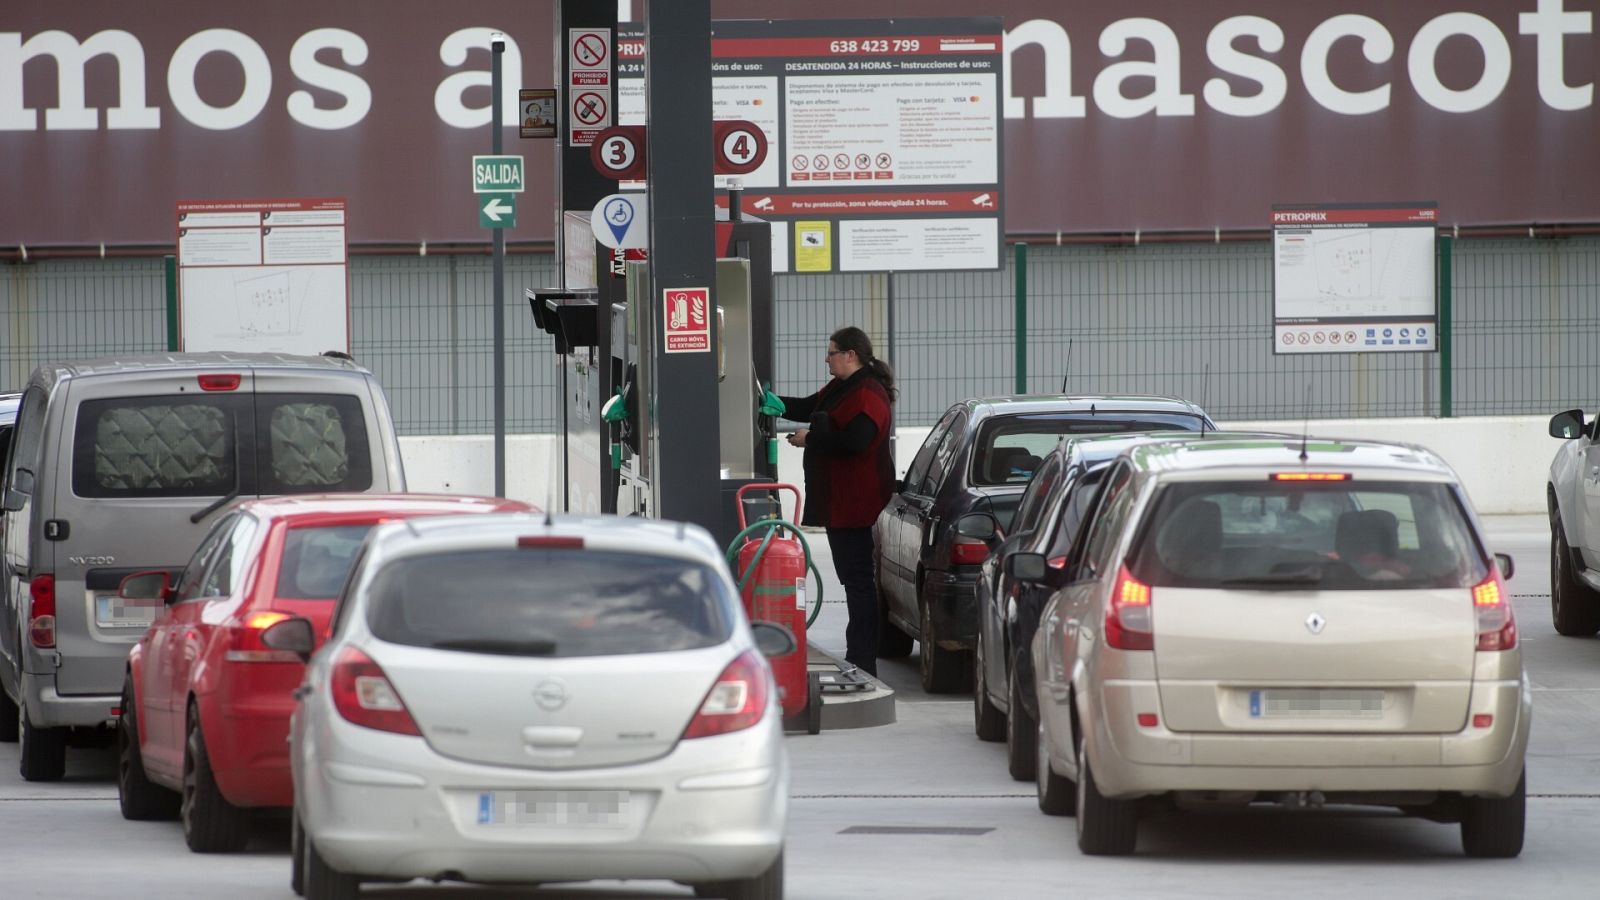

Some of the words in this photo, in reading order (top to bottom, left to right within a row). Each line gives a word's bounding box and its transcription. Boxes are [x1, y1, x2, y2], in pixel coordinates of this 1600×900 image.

[830, 41, 857, 53] 638
[861, 40, 889, 52] 423
[892, 39, 920, 52] 799
[628, 64, 639, 72] 24
[731, 62, 742, 71] de
[744, 63, 763, 71] uso:
[785, 62, 846, 71] DESATENDIDA
[848, 62, 859, 70] 24
[861, 61, 892, 70] HORAS
[901, 60, 957, 69] Instrucciones
[959, 60, 970, 68] de
[609, 140, 627, 165] 3
[731, 135, 750, 160] 4
[476, 163, 521, 185] SALIDA
[813, 200, 848, 209] protección,
[849, 200, 866, 208] zona
[867, 199, 914, 208] videovigilada
[916, 198, 925, 206] 24
[926, 198, 949, 206] horas.
[1274, 212, 1327, 221] PETROPRIX
[69, 555, 115, 565] NV200
